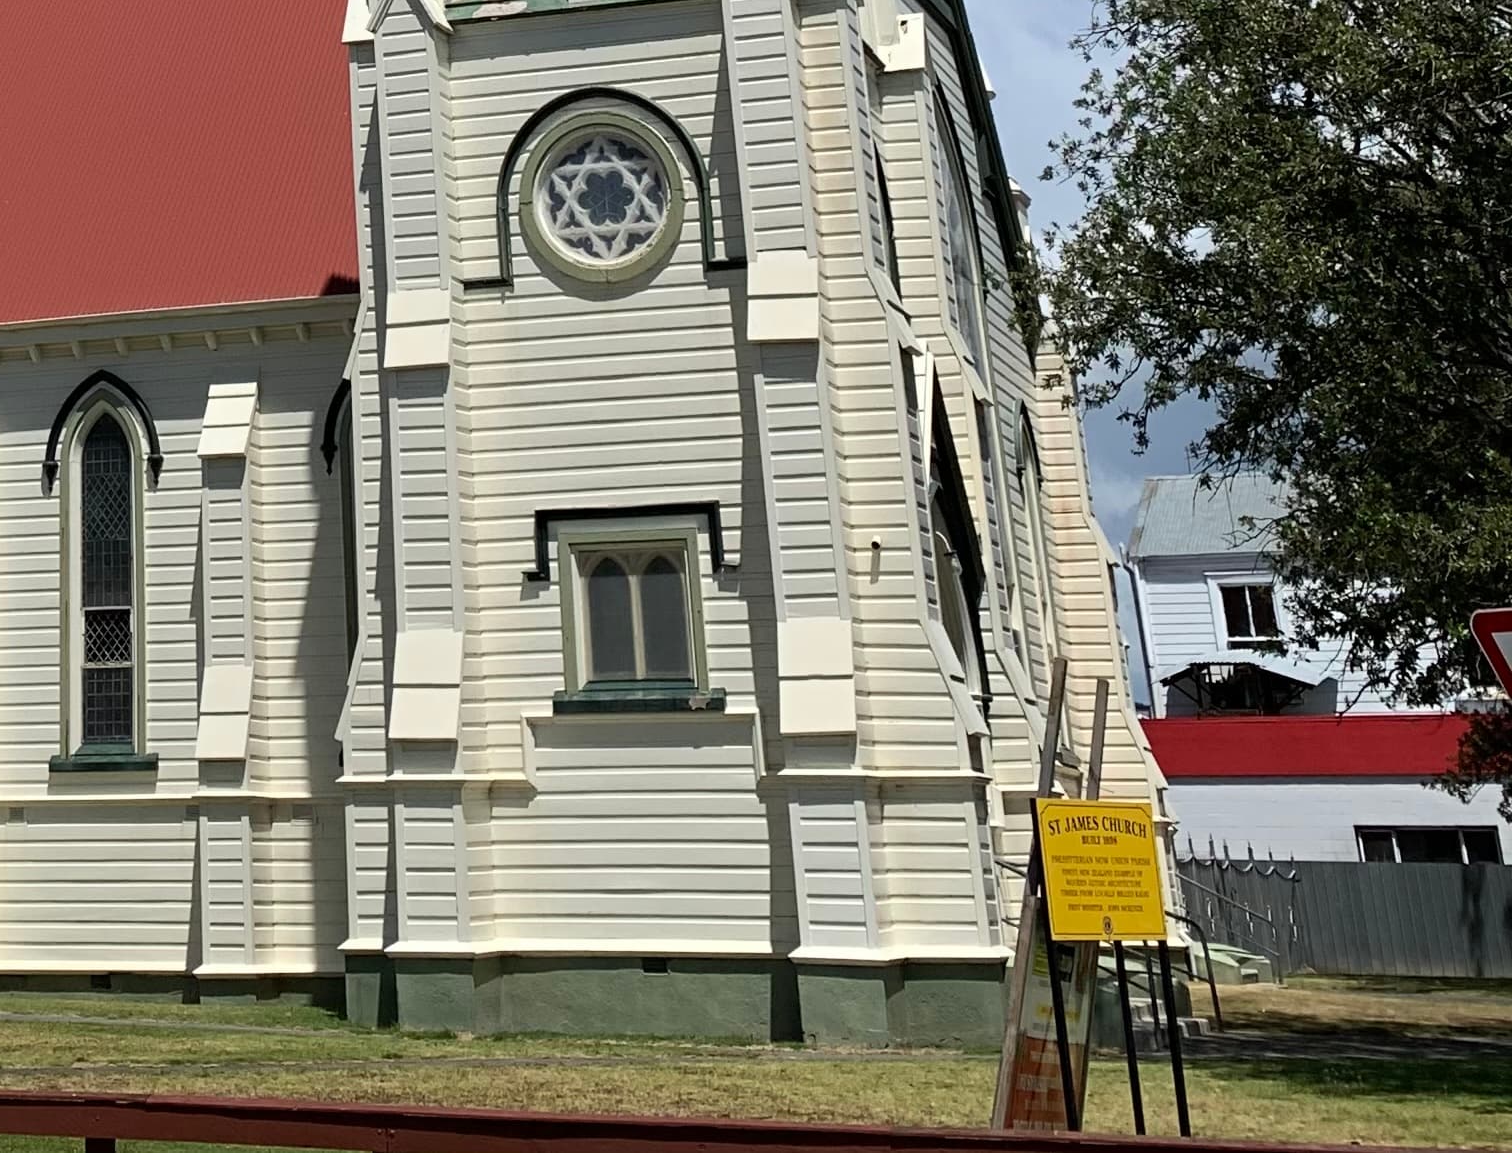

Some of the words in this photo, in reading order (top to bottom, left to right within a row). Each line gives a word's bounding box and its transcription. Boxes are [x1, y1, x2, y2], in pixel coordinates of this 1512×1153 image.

[1048, 819, 1061, 836] ST
[1064, 816, 1099, 833] JAMES
[1102, 816, 1147, 838] CHURCH
